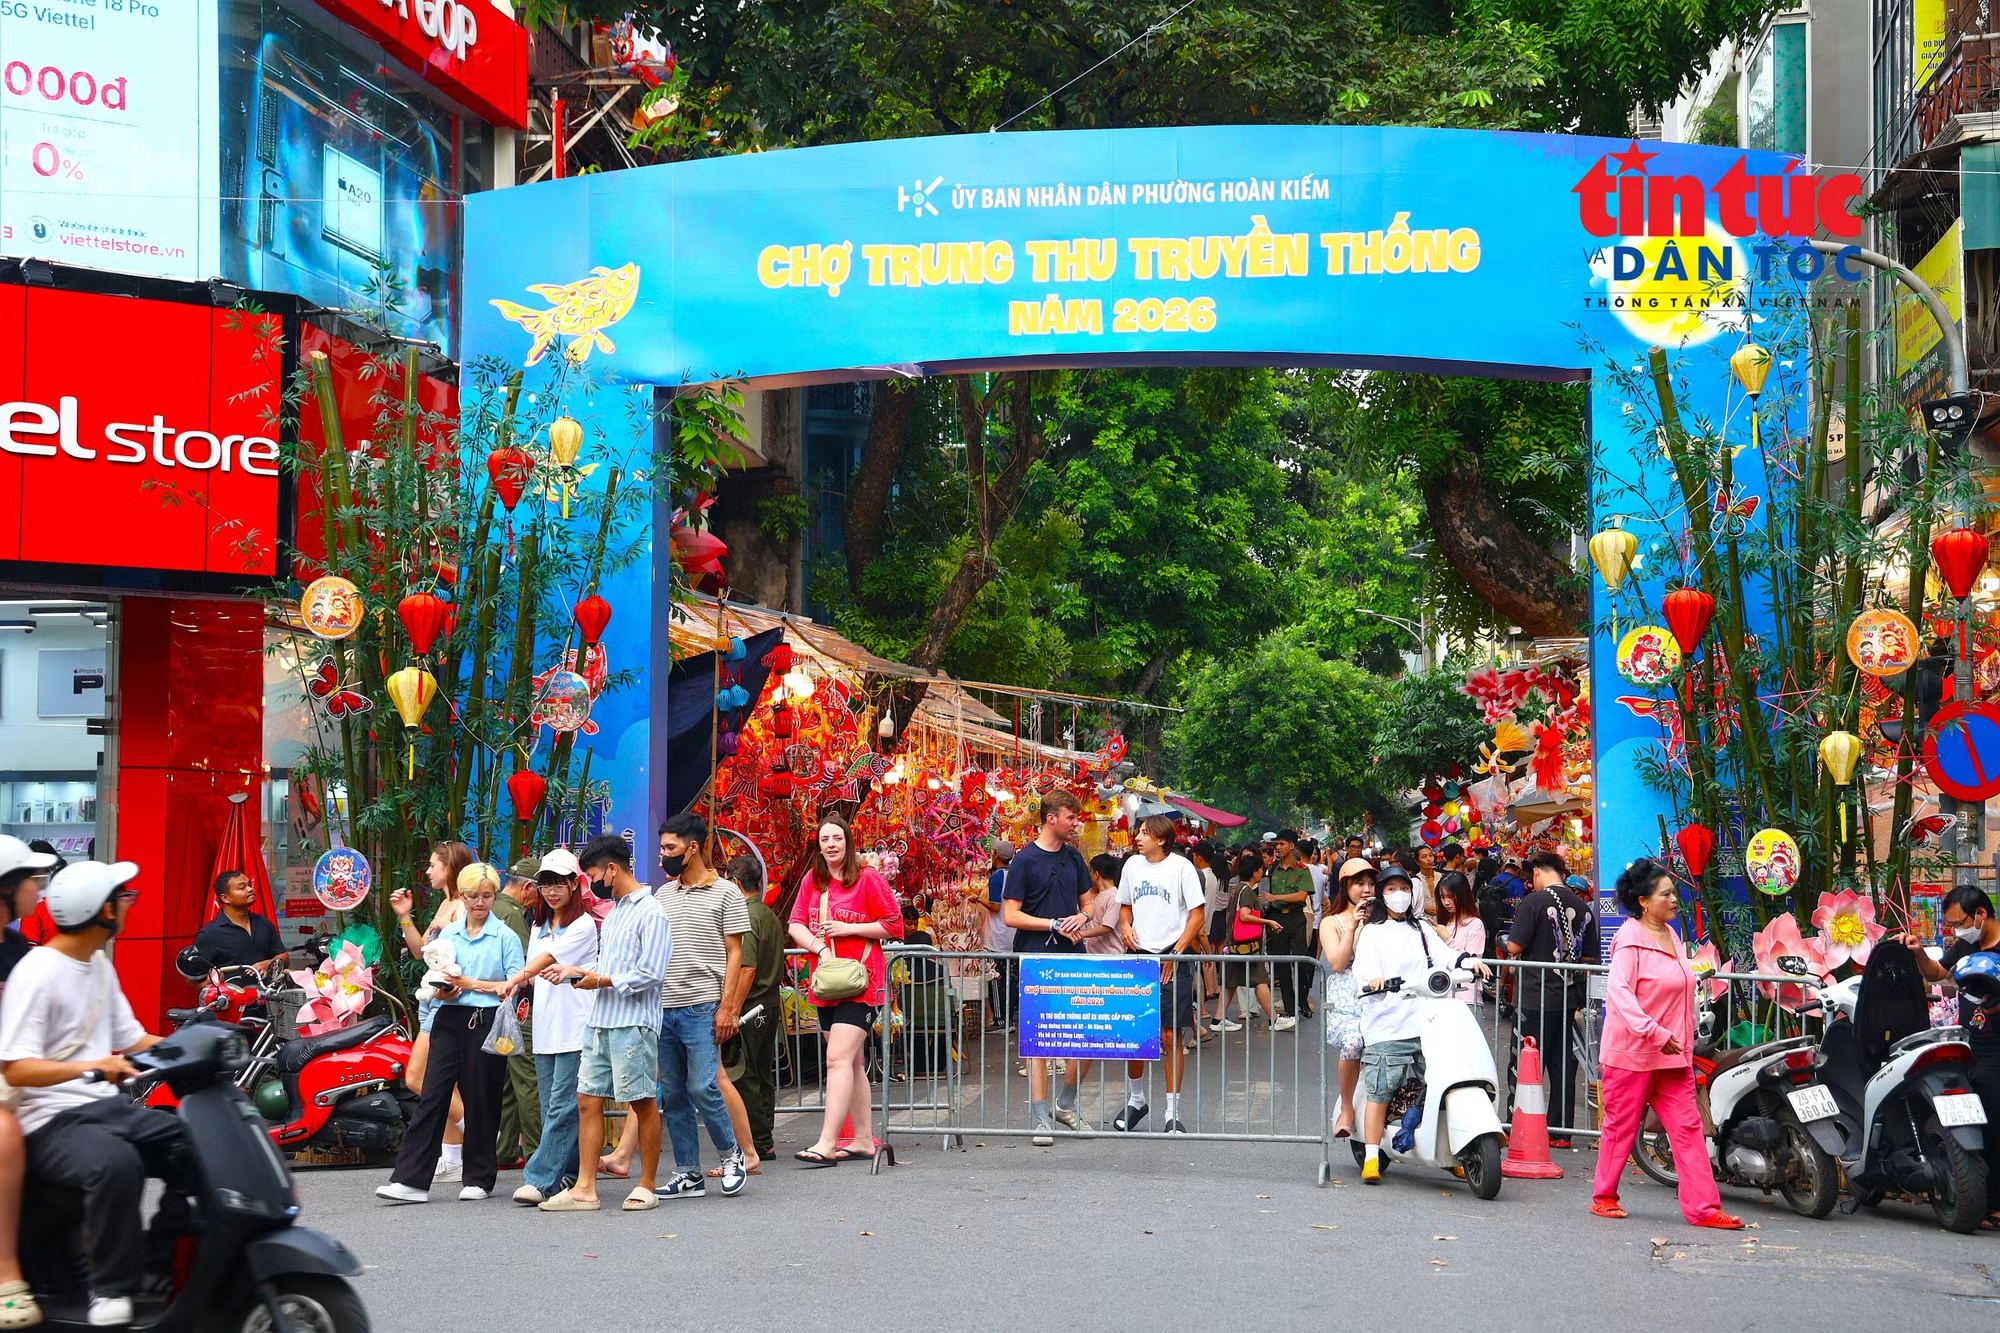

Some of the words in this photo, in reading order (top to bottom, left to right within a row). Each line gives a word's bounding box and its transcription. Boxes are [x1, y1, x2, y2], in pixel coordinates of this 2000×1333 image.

[1, 0, 28, 19] 5G
[33, 6, 95, 31] Viettel
[129, 0, 160, 18] Pro
[348, 184, 371, 204] A20
[951, 182, 977, 209] ỦY
[982, 188, 1021, 208] BAN
[1026, 182, 1080, 207] NHÂN
[1087, 181, 1126, 206] DÂN
[1132, 178, 1215, 204] PHƯỜNG
[1221, 176, 1275, 203] HOÀN
[1281, 173, 1330, 200] KIẾM
[60, 233, 185, 259] viettelstore.vn
[757, 240, 853, 297] CHỢ
[862, 240, 1014, 287] TRUNG
[1025, 238, 1117, 283] THU
[1128, 215, 1309, 281] TRUYỀN
[1320, 211, 1481, 275] THỐNG
[1009, 294, 1103, 335] NĂM
[1112, 296, 1217, 333] 2026
[104, 414, 280, 476] store
[1087, 997, 1105, 1006] 2026
